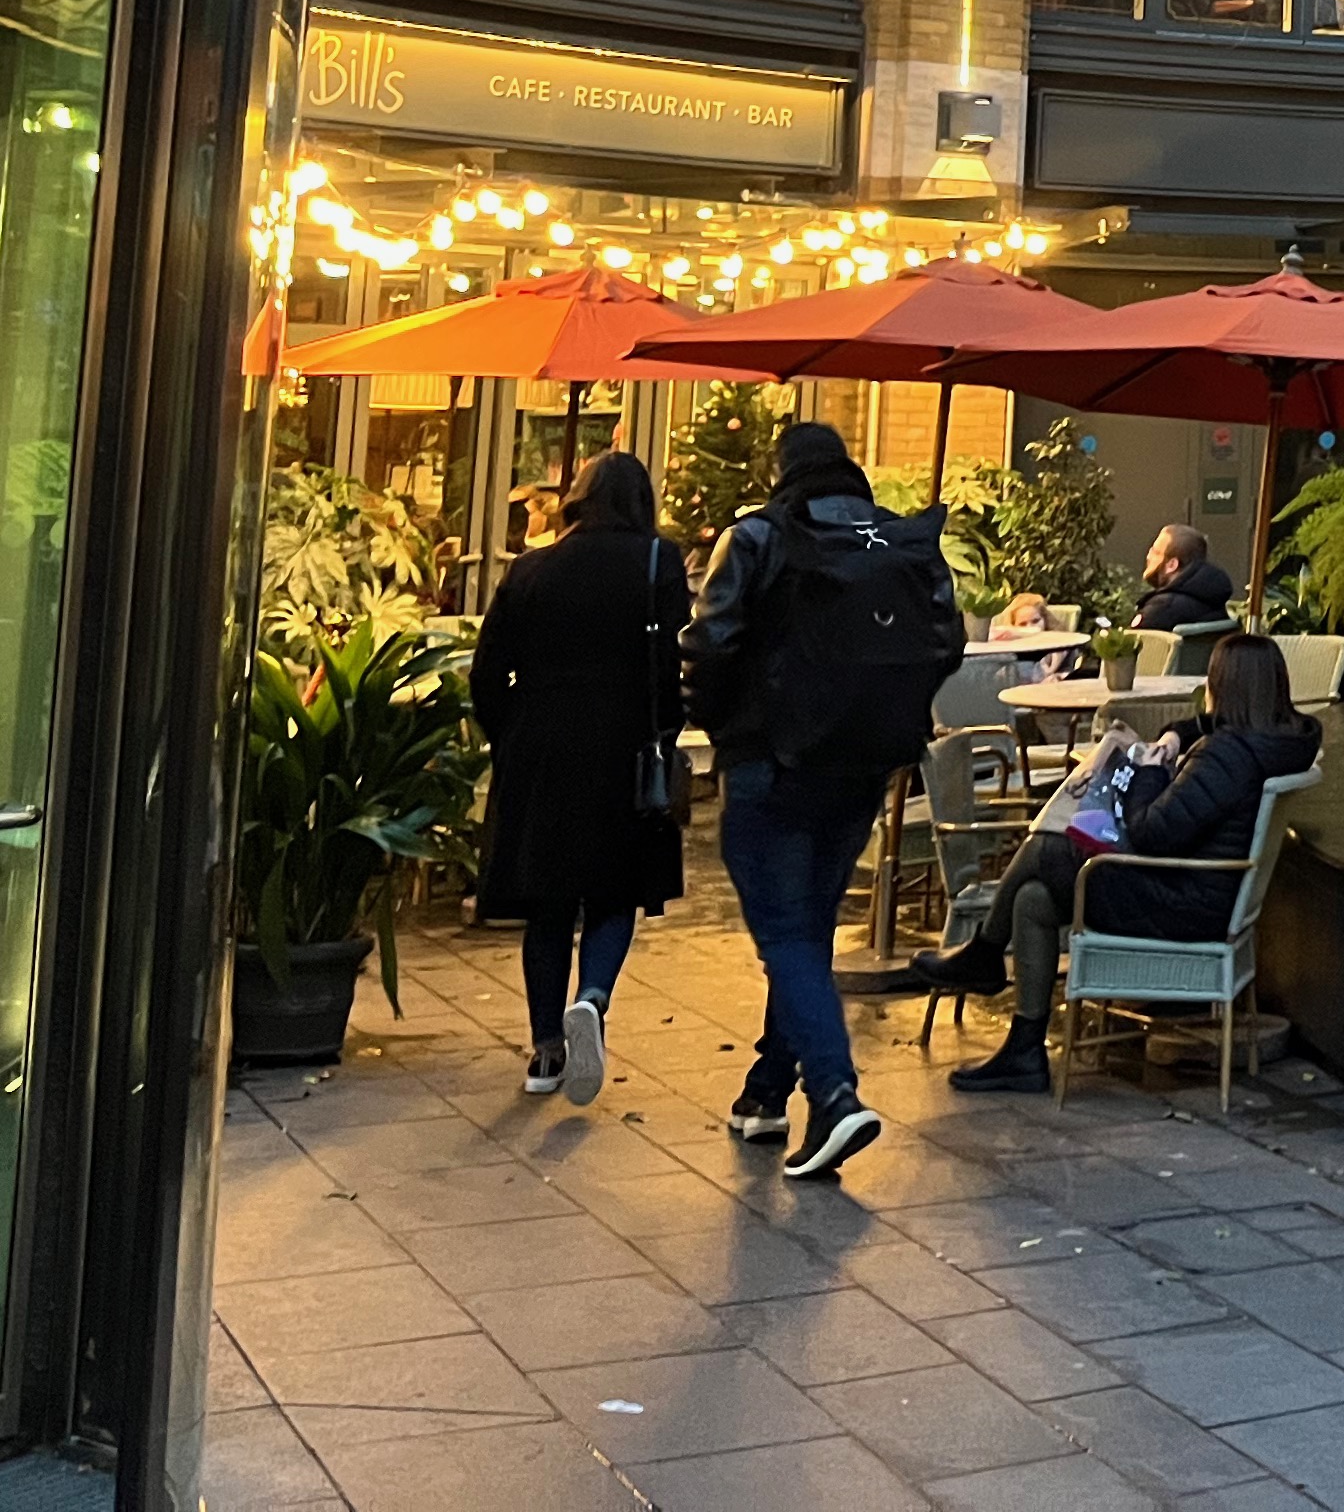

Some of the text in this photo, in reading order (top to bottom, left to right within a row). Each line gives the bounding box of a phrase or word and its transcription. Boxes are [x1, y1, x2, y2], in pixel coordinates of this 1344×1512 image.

[309, 30, 405, 113] Bill's
[489, 75, 793, 128] CAFE RESTAURANT BAR
